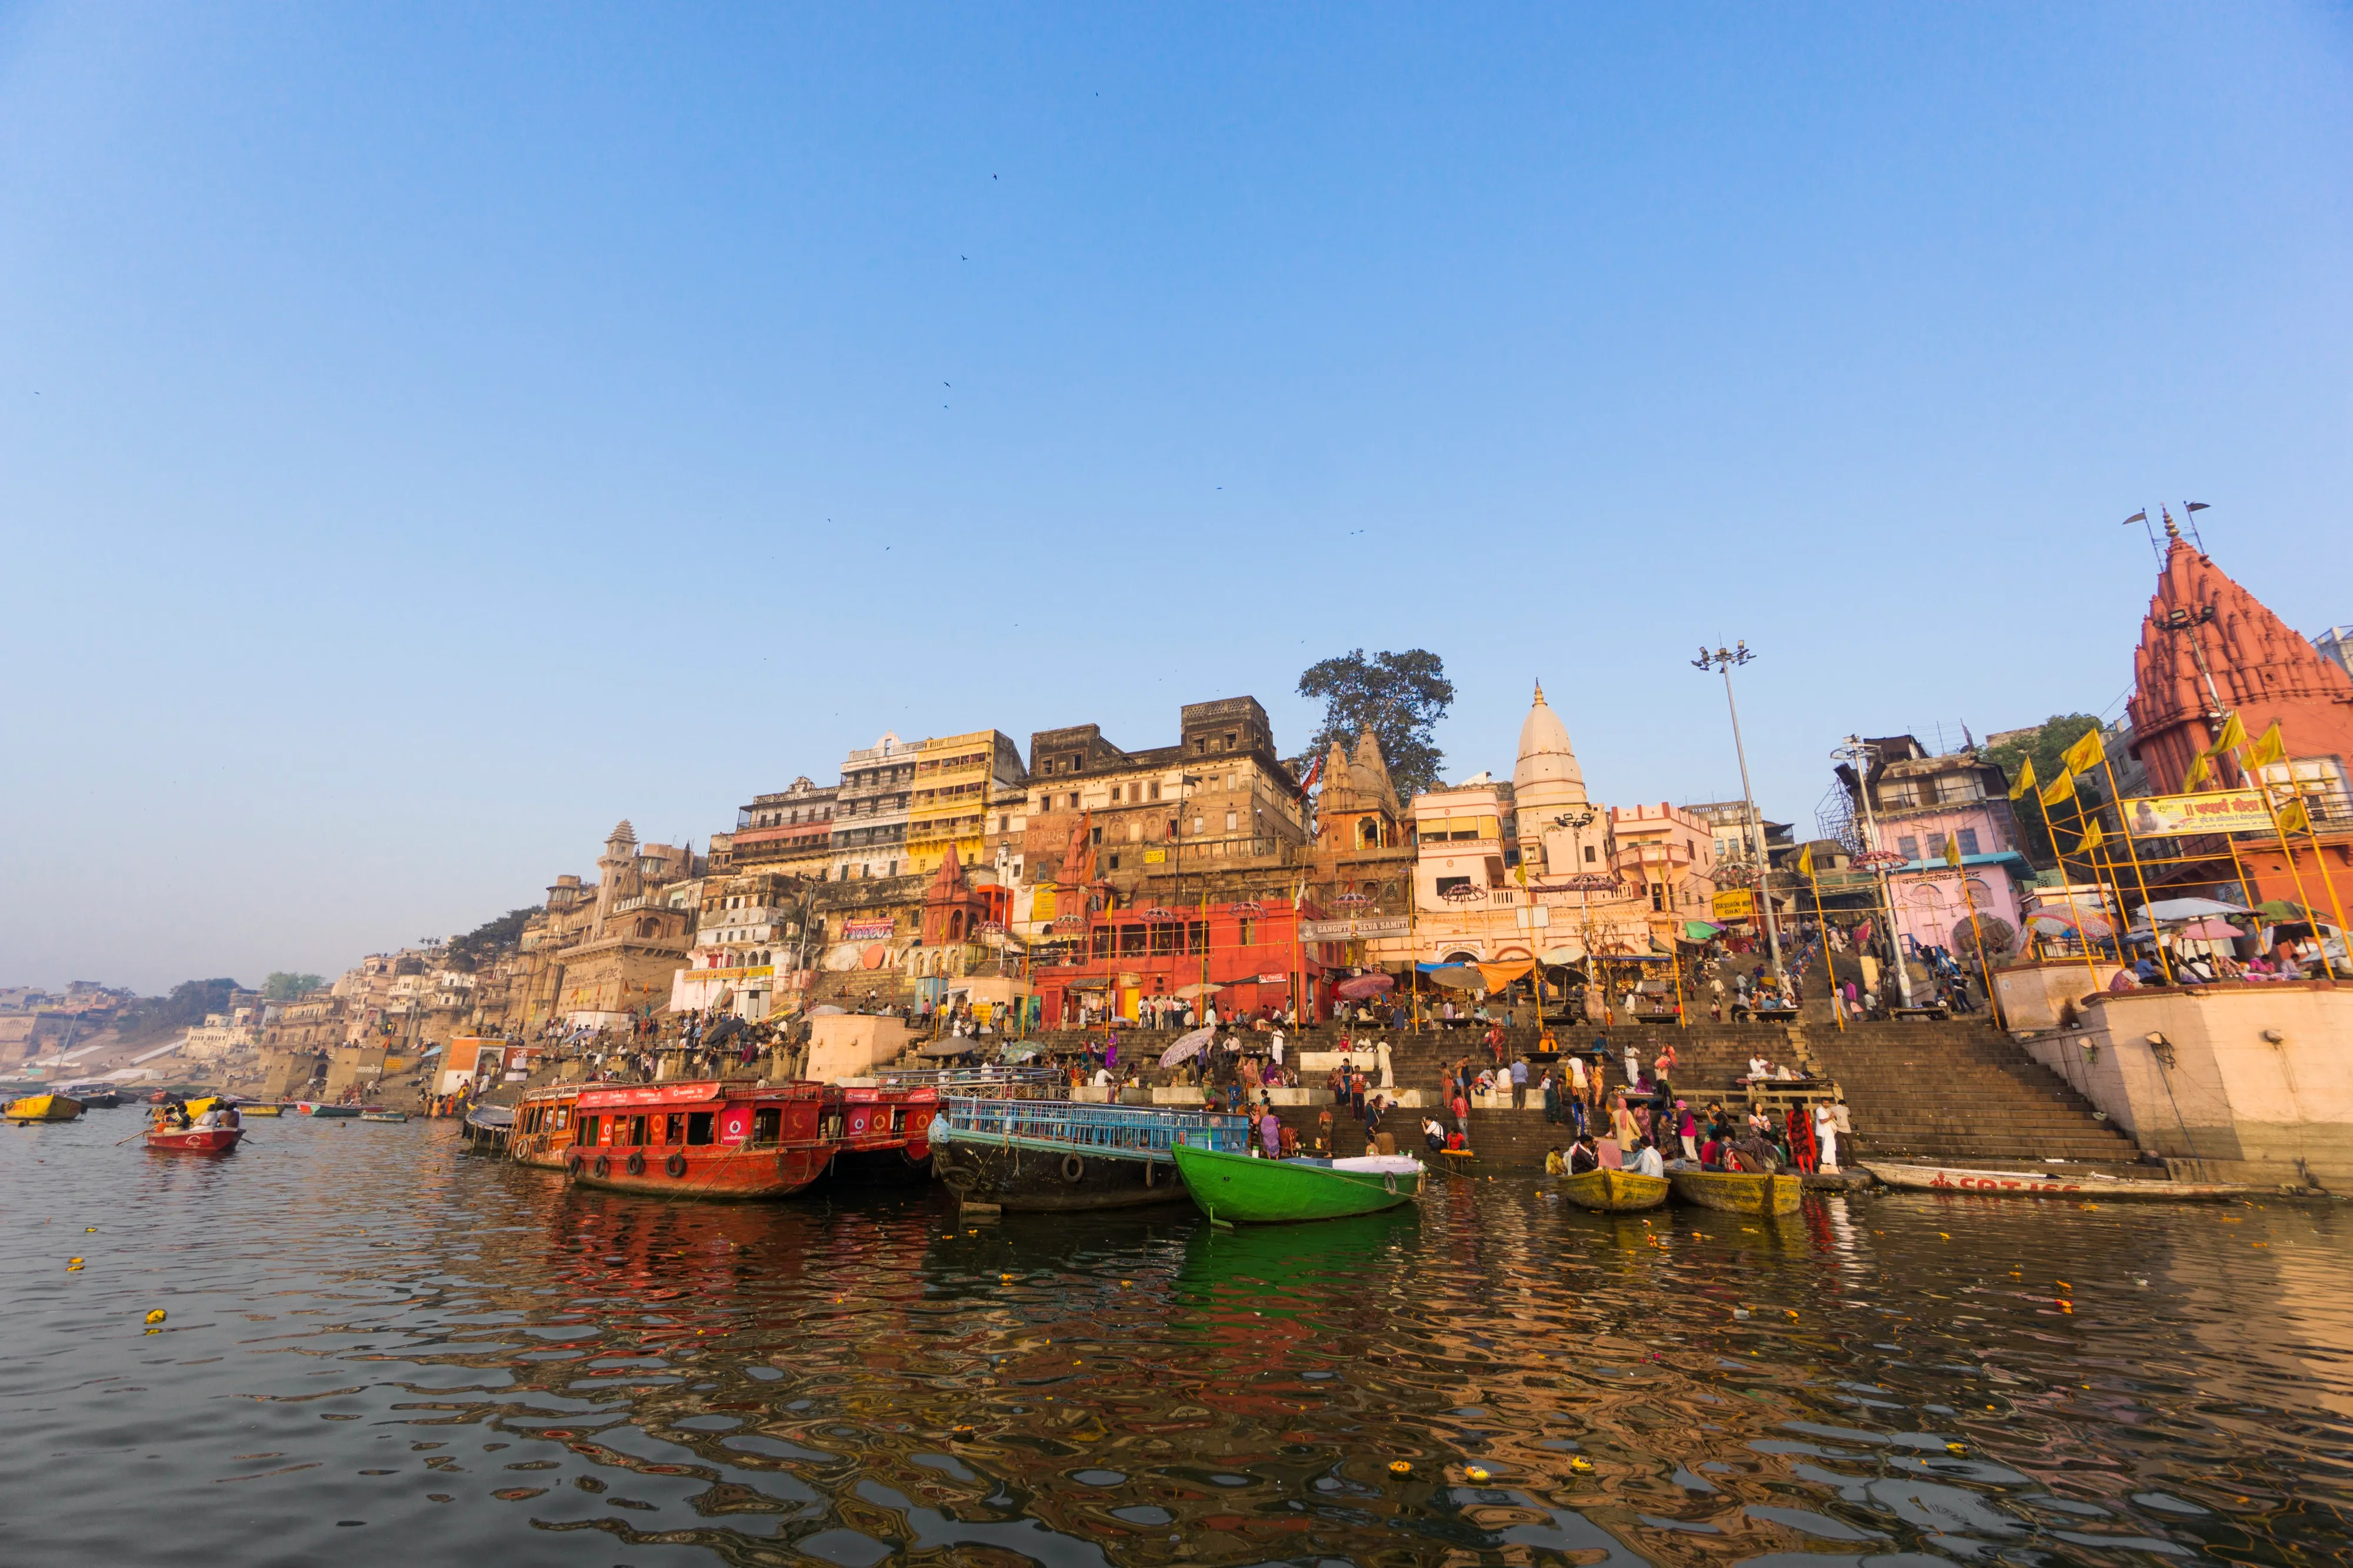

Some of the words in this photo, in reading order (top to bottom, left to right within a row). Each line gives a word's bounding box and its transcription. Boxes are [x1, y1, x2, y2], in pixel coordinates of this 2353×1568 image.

[2231, 797, 2260, 813] गीता
[1317, 924, 1355, 933] GANGOTR
[1358, 922, 1378, 931] SEVA
[1380, 919, 1409, 929] SAMITI
[696, 970, 712, 979] GANGA
[714, 969, 724, 978] SILK
[725, 968, 750, 977] FACTOY
[548, 1146, 564, 1161] airt
